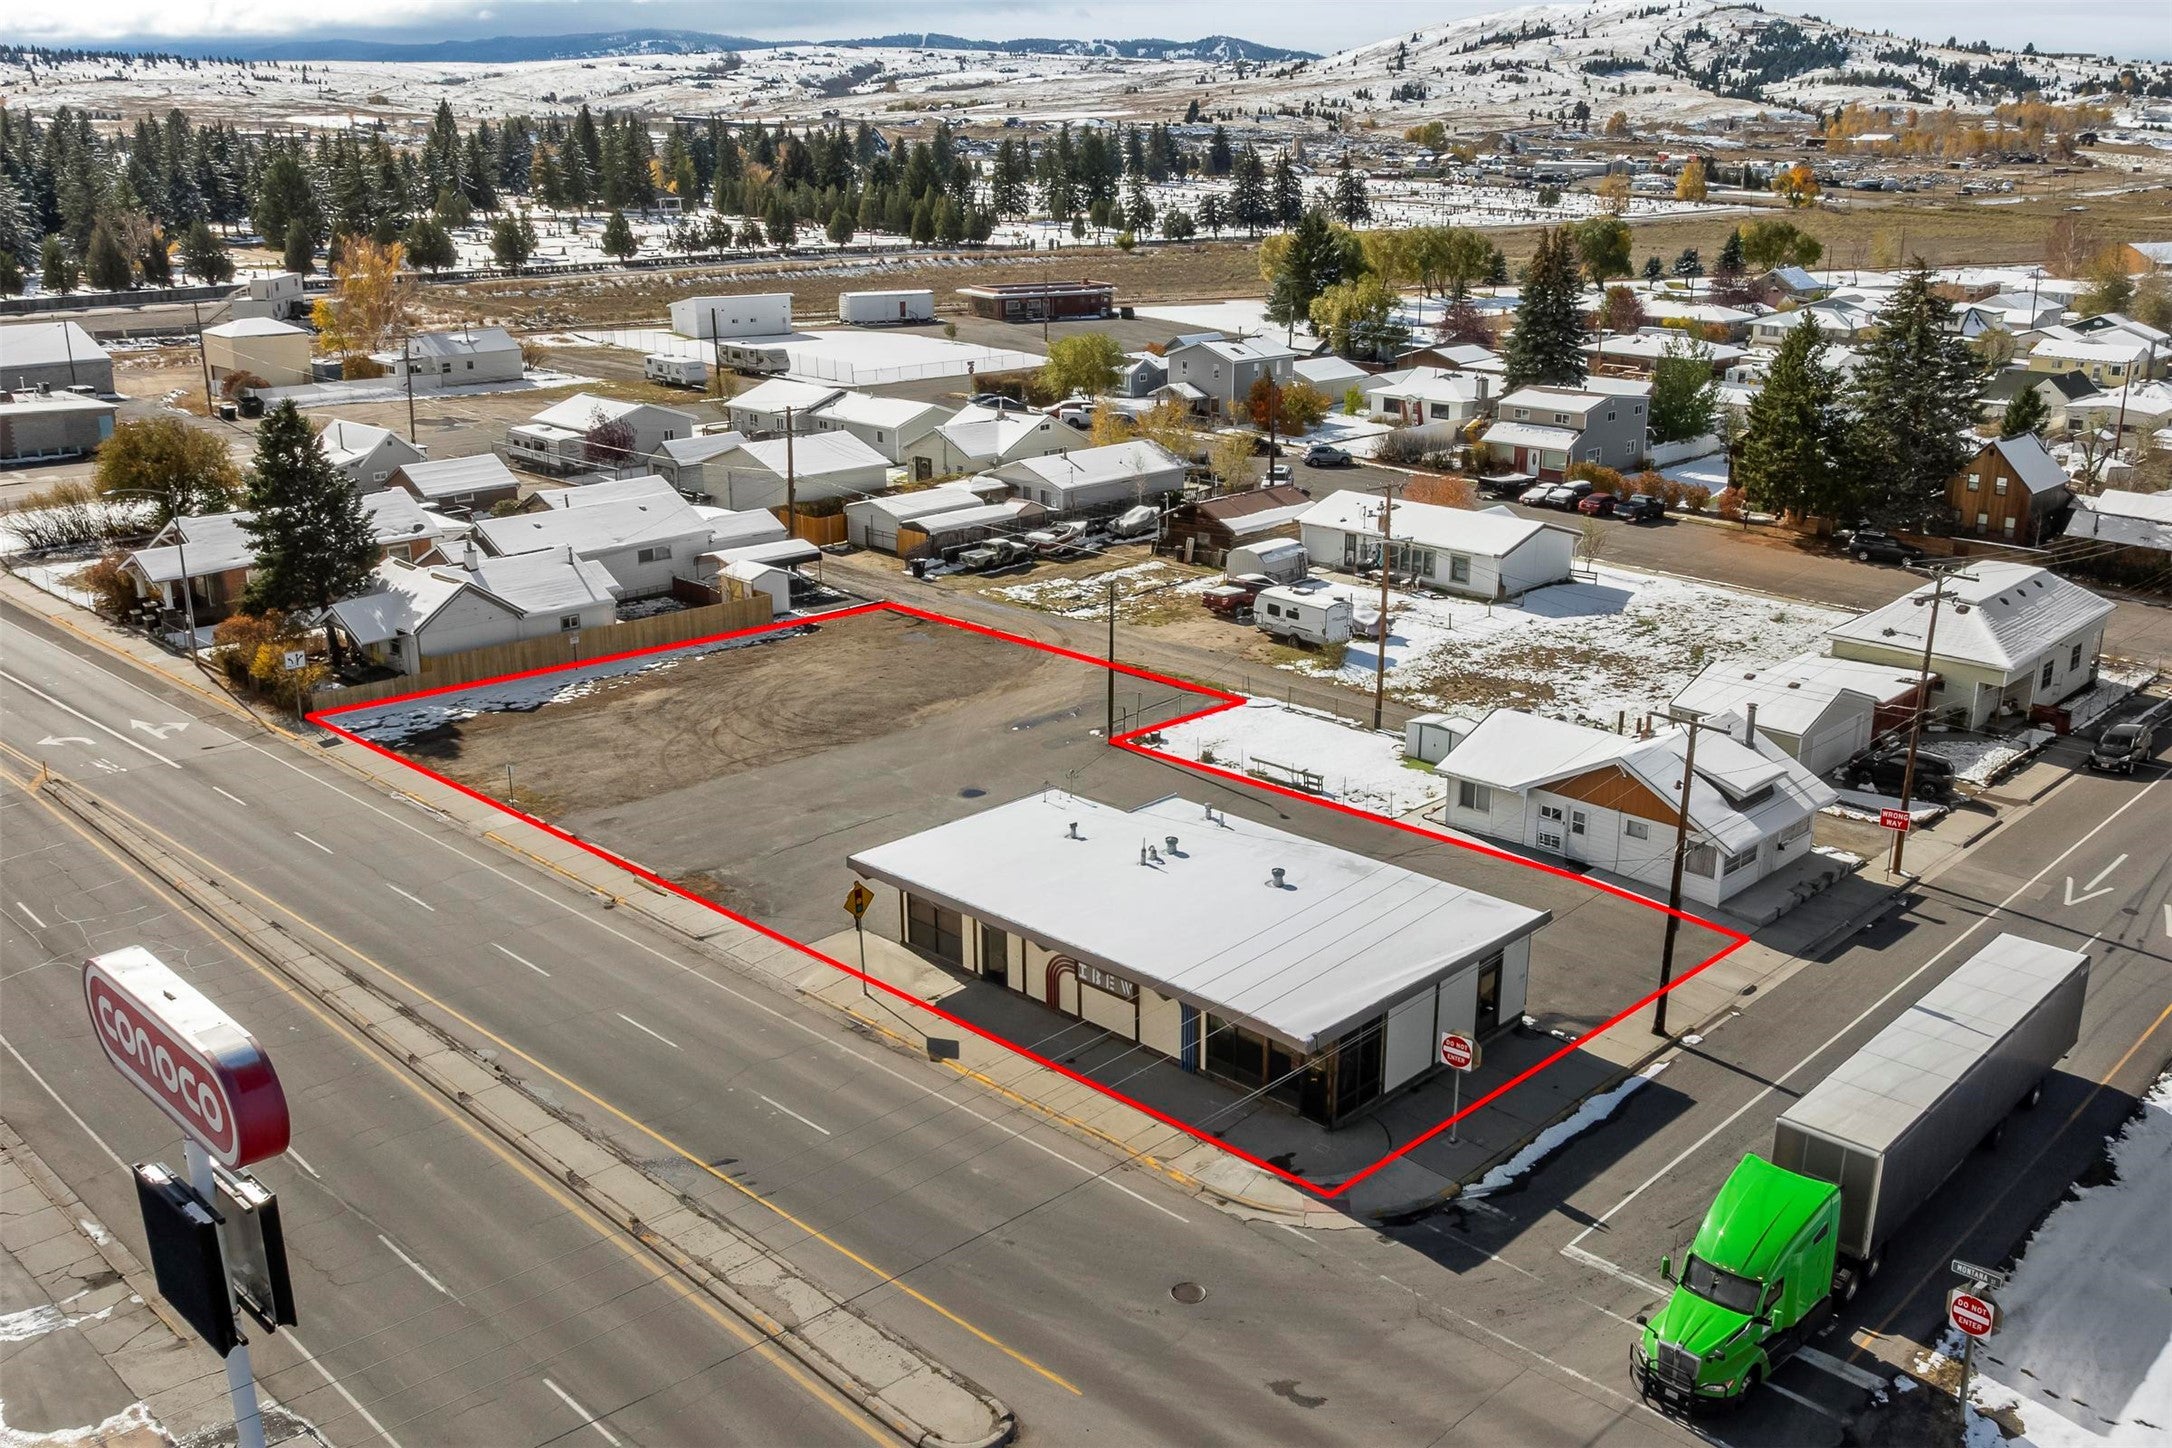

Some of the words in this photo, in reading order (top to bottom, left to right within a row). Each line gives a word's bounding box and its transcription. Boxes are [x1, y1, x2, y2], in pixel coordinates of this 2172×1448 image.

[1882, 810, 1909, 821] WRONG
[1886, 819, 1903, 828] WAY
[1078, 962, 1133, 996] IBEW
[1445, 1039, 1455, 1047] DO
[1456, 1042, 1468, 1051] NOT
[1447, 1053, 1466, 1064] ENTER
[1956, 1264, 1988, 1281] MONTANA
[1957, 1299, 1969, 1309] DO
[1971, 1303, 1987, 1317] NOT
[1958, 1316, 1982, 1331] ENTER
